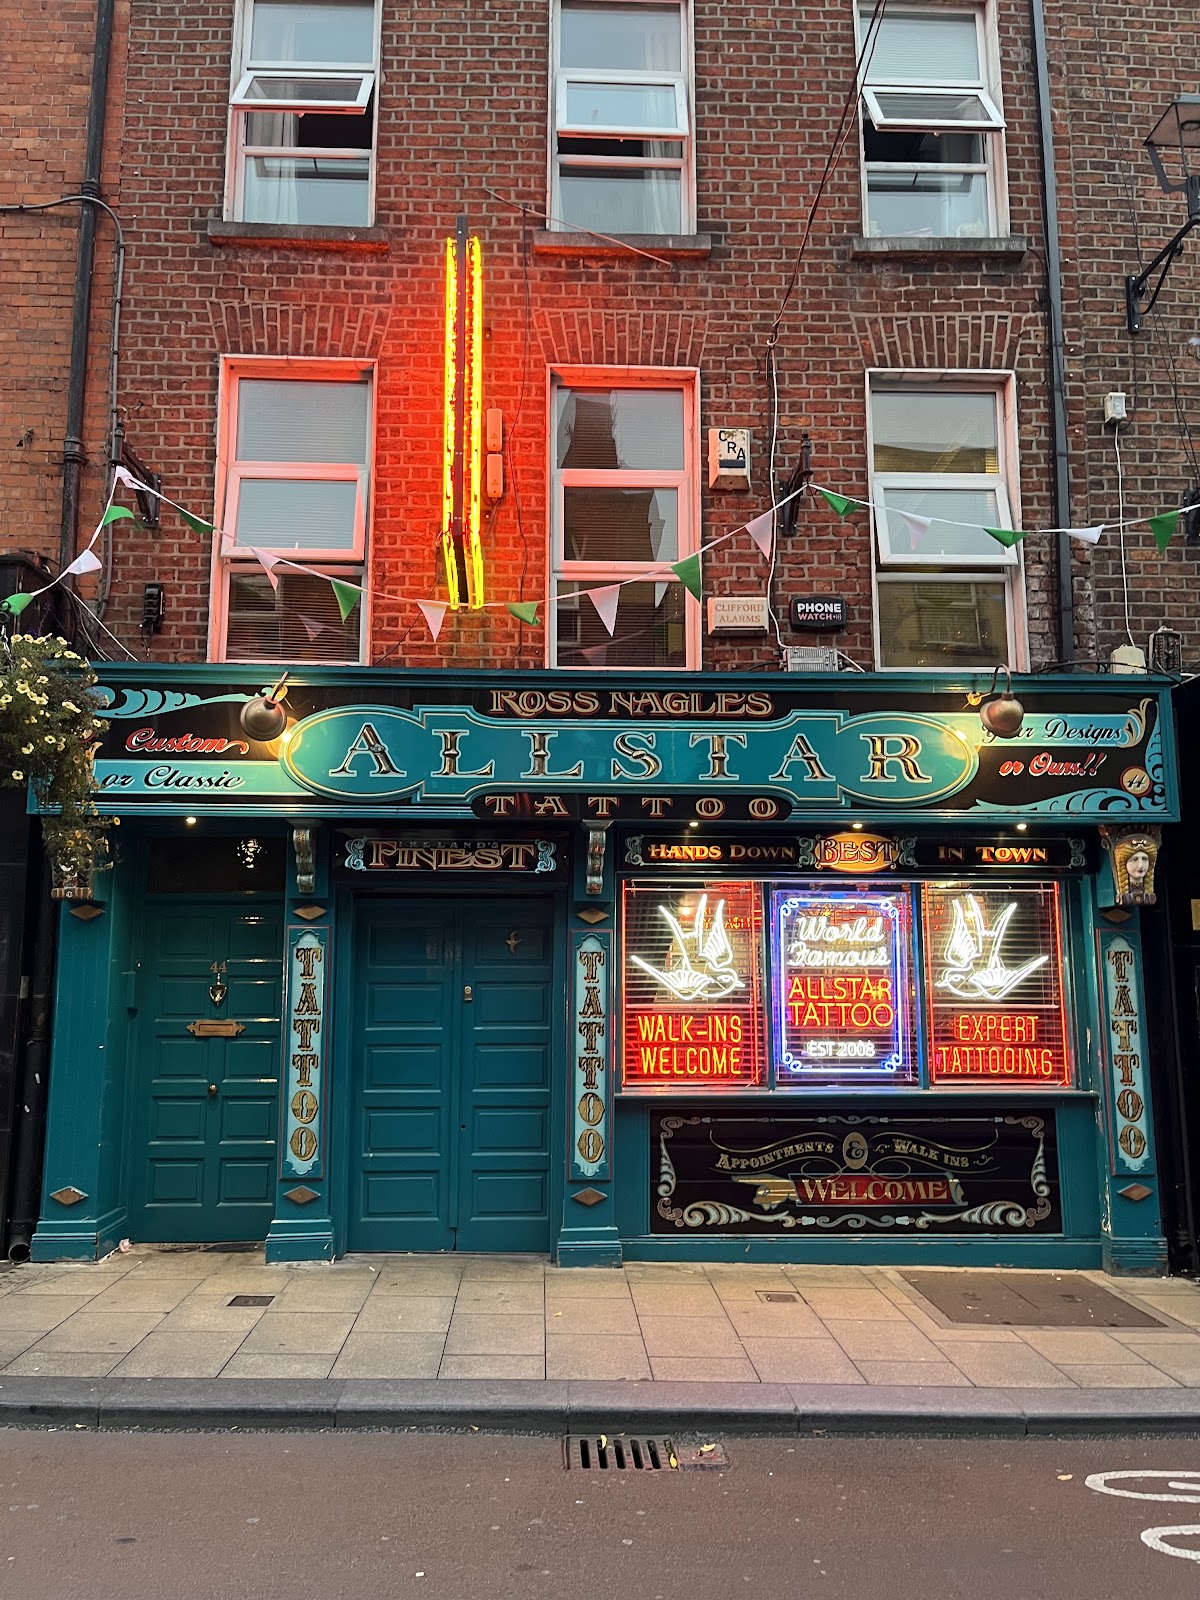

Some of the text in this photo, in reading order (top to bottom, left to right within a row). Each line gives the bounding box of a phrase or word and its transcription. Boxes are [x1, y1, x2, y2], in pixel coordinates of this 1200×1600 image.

[715, 603, 764, 612] CLIFFORD
[719, 615, 760, 623] ALARMS
[797, 602, 842, 613] PHONE
[798, 612, 833, 621] WATCH
[489, 690, 601, 718] ROSS
[124, 727, 250, 755] Custom
[1041, 718, 1123, 745] Designs
[329, 721, 934, 784] ALLSTAR
[998, 751, 1108, 777] or Ours!!
[101, 765, 246, 790] or Classic
[1127, 773, 1148, 790] 44
[484, 795, 780, 819] TATTOO
[368, 840, 538, 871] FINEST
[399, 841, 499, 849] IRELAND'S
[647, 843, 795, 862] HANDS DOWN
[817, 838, 899, 865] BEST
[937, 845, 1048, 864] IN TOWN
[796, 916, 885, 943] World
[786, 940, 892, 967] Famous
[209, 960, 228, 974] 44
[787, 976, 893, 1001] ALLSTAR
[787, 1001, 894, 1027] TATTOO
[637, 1014, 743, 1043] WALK-INS
[958, 1014, 1039, 1043] EXPERT
[289, 947, 323, 1162] TATTOO
[577, 951, 606, 1164] TATTOO
[640, 1046, 742, 1075] WELCOME
[806, 1039, 876, 1058] EST 2008
[937, 1046, 1053, 1075] TATTOOING
[1107, 950, 1147, 1159] TATTOO
[715, 1141, 834, 1171] APPOINTMENTS
[892, 1138, 938, 1161] WALK
[943, 1154, 970, 1169] INS
[801, 1178, 949, 1203] WELCOME
